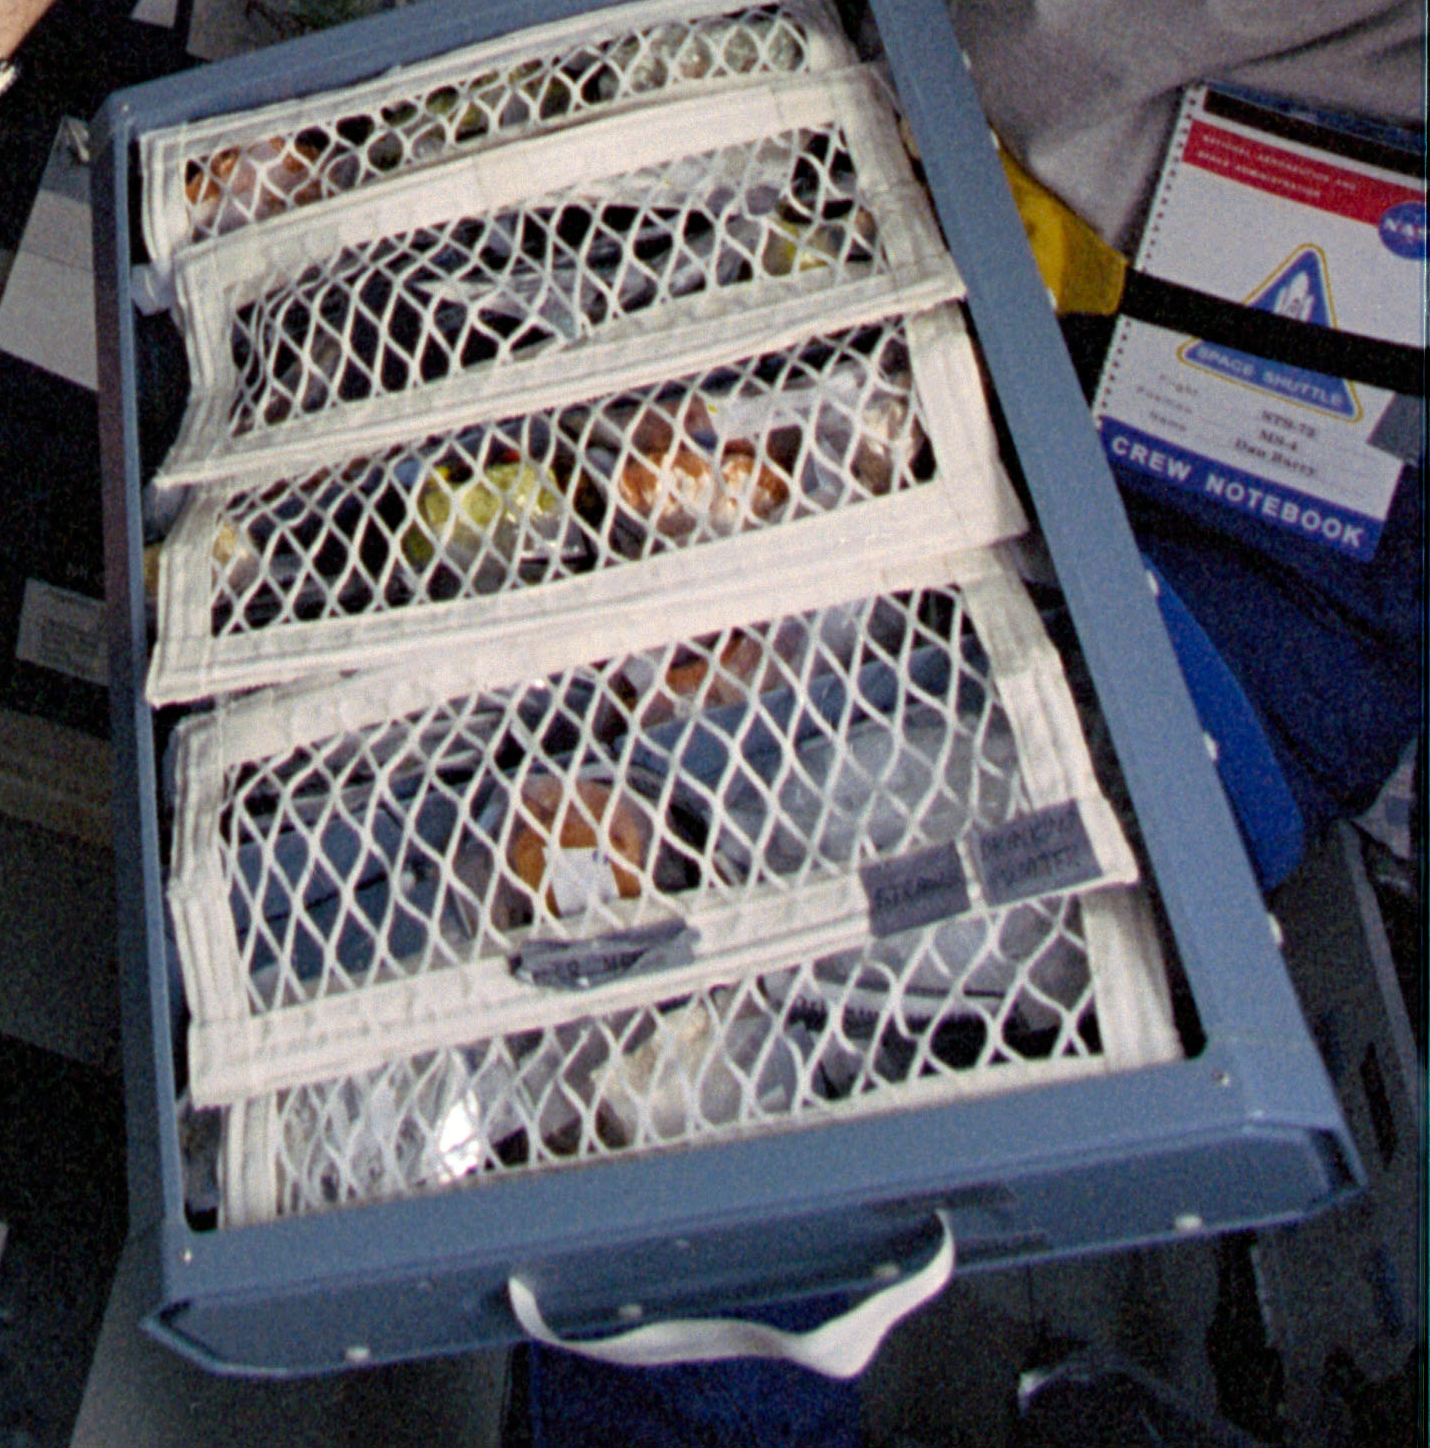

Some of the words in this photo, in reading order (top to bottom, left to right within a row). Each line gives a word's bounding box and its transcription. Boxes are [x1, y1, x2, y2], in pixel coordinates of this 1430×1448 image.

[1196, 345, 1256, 377] SPACE
[1262, 370, 1344, 406] SHUTTLE
[1261, 409, 1316, 438] STS-72
[1235, 437, 1267, 458] Dan
[1271, 450, 1316, 477] Barry
[1112, 436, 1192, 481] CREW
[1205, 474, 1365, 549] NOTEBOOK
